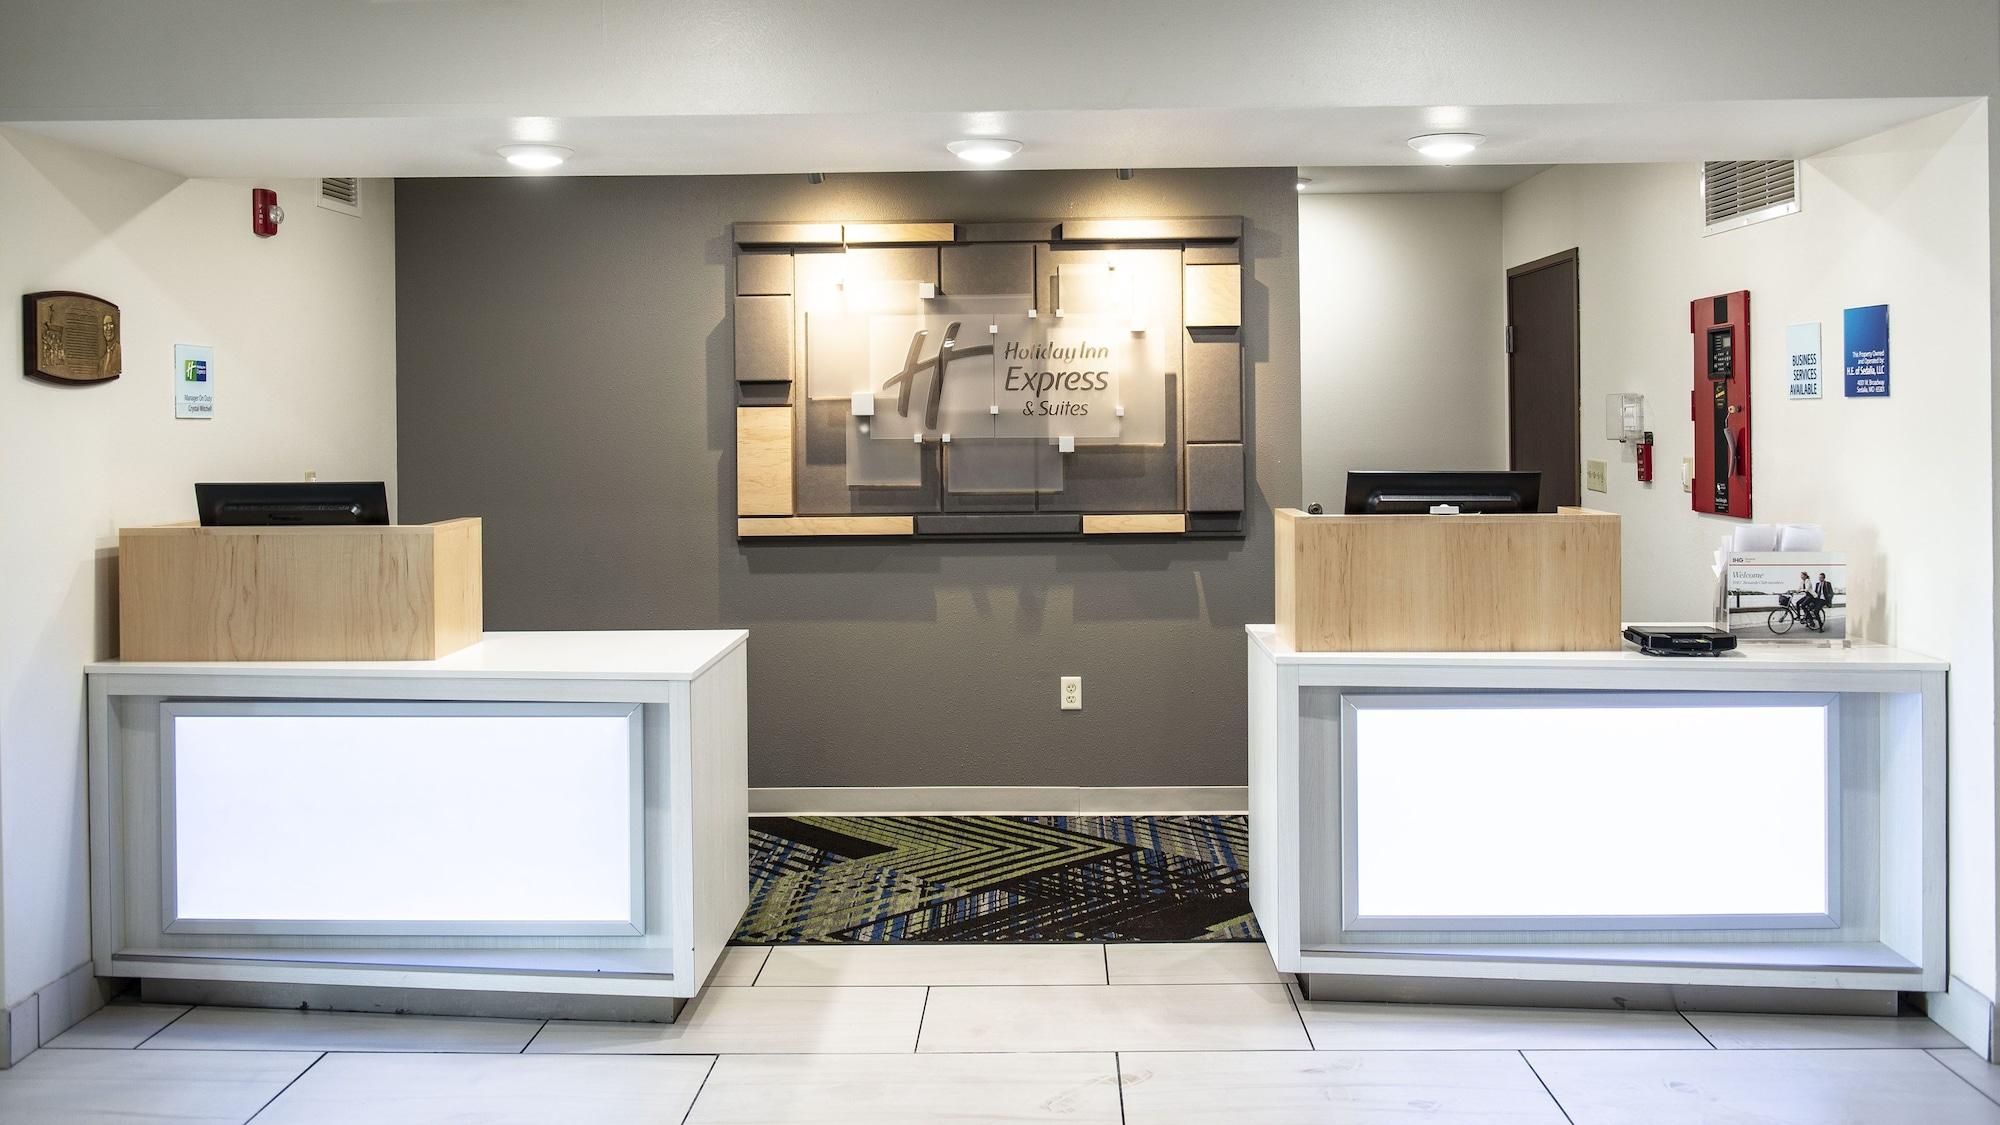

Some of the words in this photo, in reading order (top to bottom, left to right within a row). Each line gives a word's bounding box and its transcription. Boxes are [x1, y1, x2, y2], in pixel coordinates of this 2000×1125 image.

[1004, 341, 1077, 364] Holiday
[1079, 341, 1109, 359] Inn
[1792, 353, 1817, 366] BUSINESS
[1793, 368, 1817, 380] SERVICES
[1876, 365, 1885, 375] LLC
[1004, 366, 1109, 398] Express
[1790, 383, 1817, 395] AVAILABLE
[1022, 400, 1034, 416] &
[1038, 400, 1089, 416] Suites
[1732, 571, 1765, 579] Welcome
